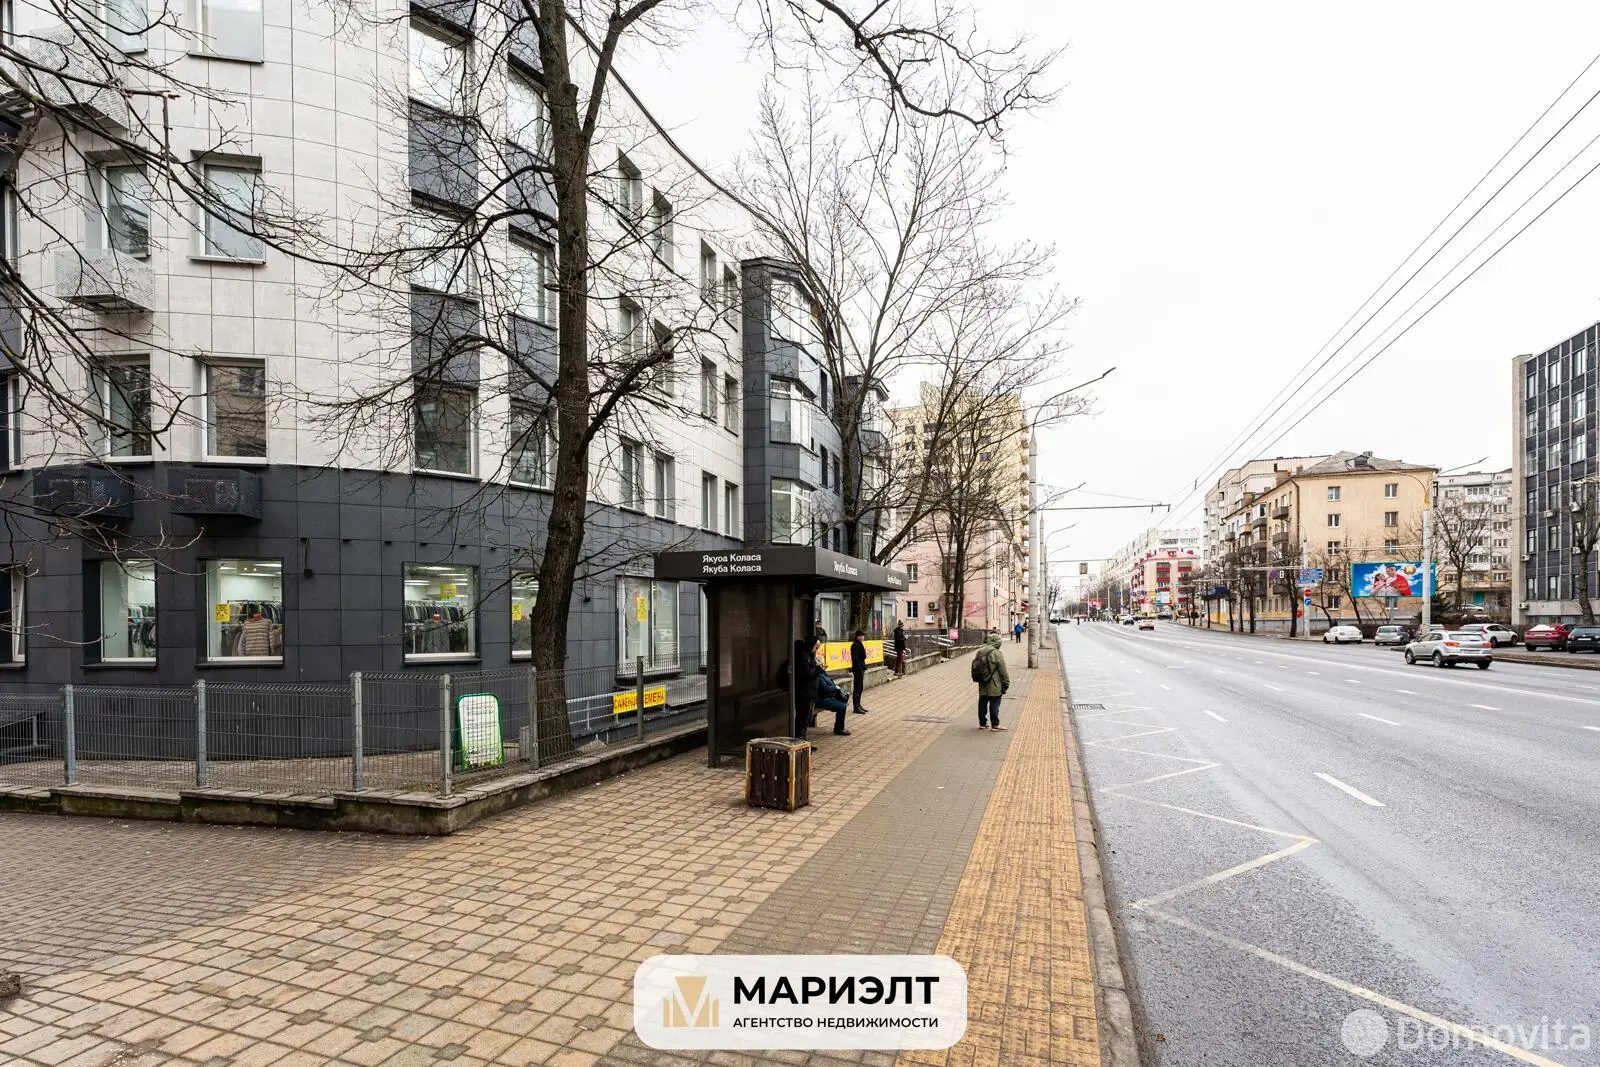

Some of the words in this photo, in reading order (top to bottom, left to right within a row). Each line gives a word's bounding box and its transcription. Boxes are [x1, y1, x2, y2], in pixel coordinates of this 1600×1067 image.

[730, 554, 762, 562] Коласа
[702, 565, 728, 575] Якуба
[730, 564, 762, 572] Коласа
[645, 691, 664, 704] ЕМЕНА
